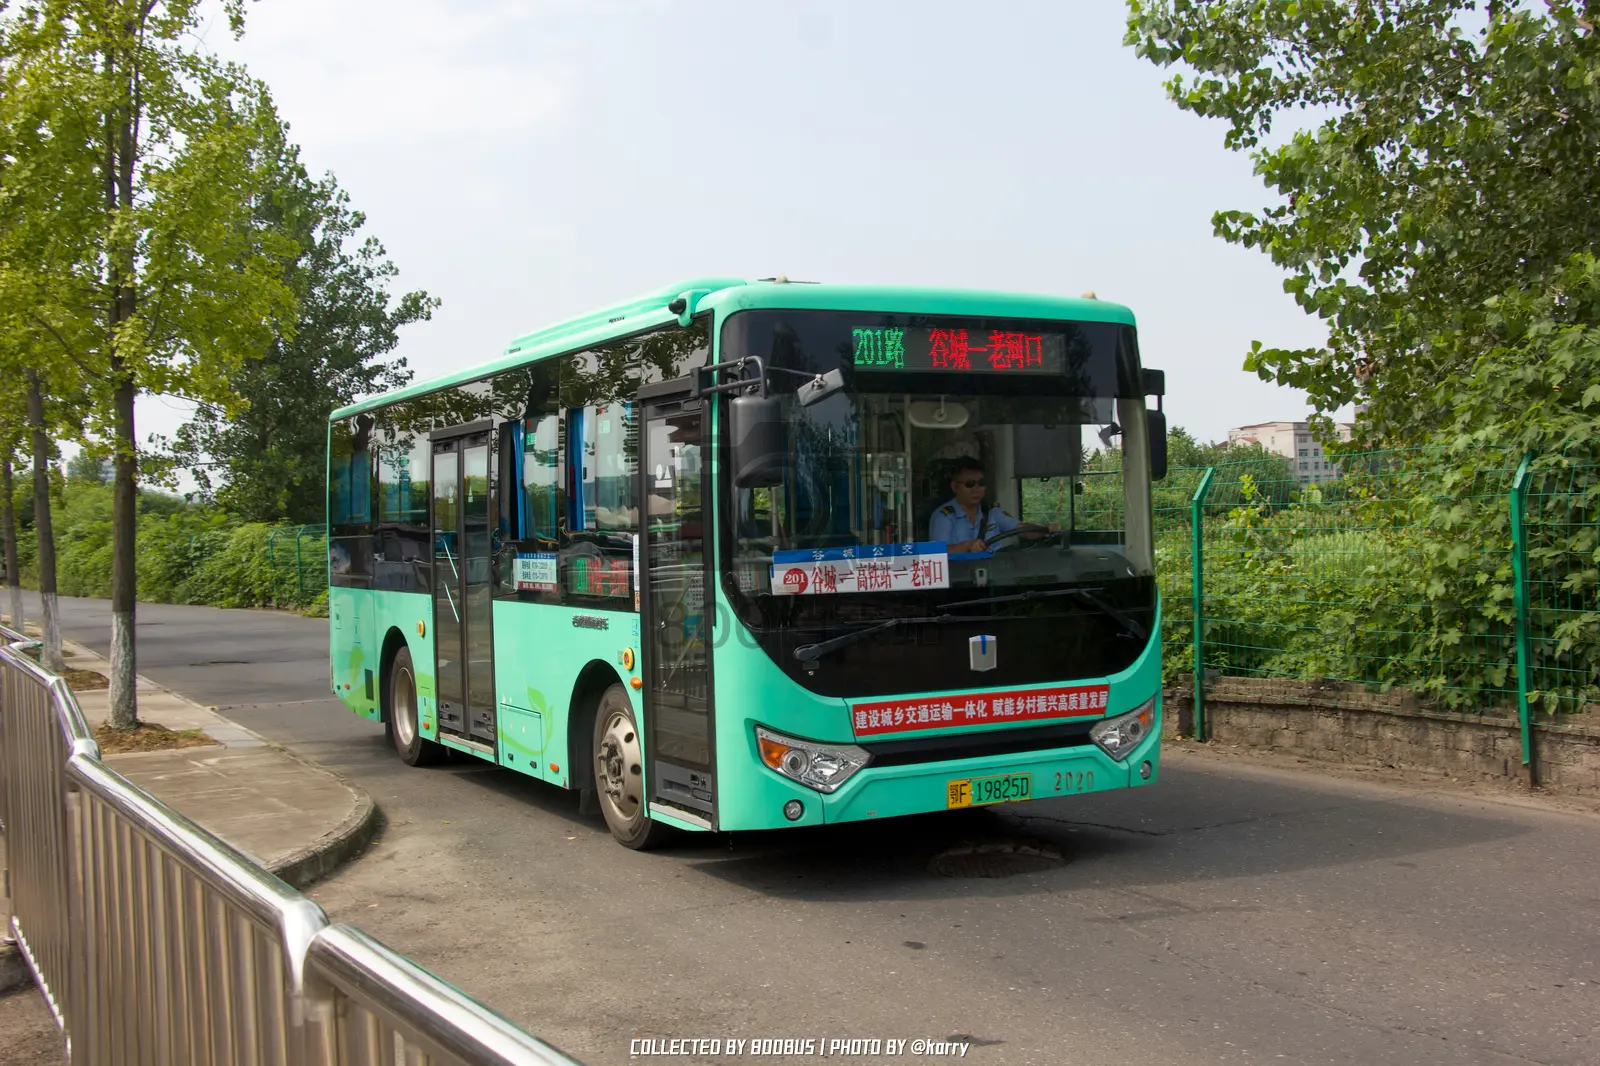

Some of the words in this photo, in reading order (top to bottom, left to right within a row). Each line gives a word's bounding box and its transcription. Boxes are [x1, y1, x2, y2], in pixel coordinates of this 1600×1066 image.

[852, 327, 905, 369] 201路
[785, 573, 807, 585] 201
[811, 566, 838, 594] 谷城
[855, 561, 892, 592] 高铁站
[909, 559, 943, 587] 老河口
[855, 700, 987, 730] 建设城乡交通运输一体化
[992, 690, 1108, 717] 赋能乡村振兴高质量发展
[1053, 771, 1094, 791] 2020
